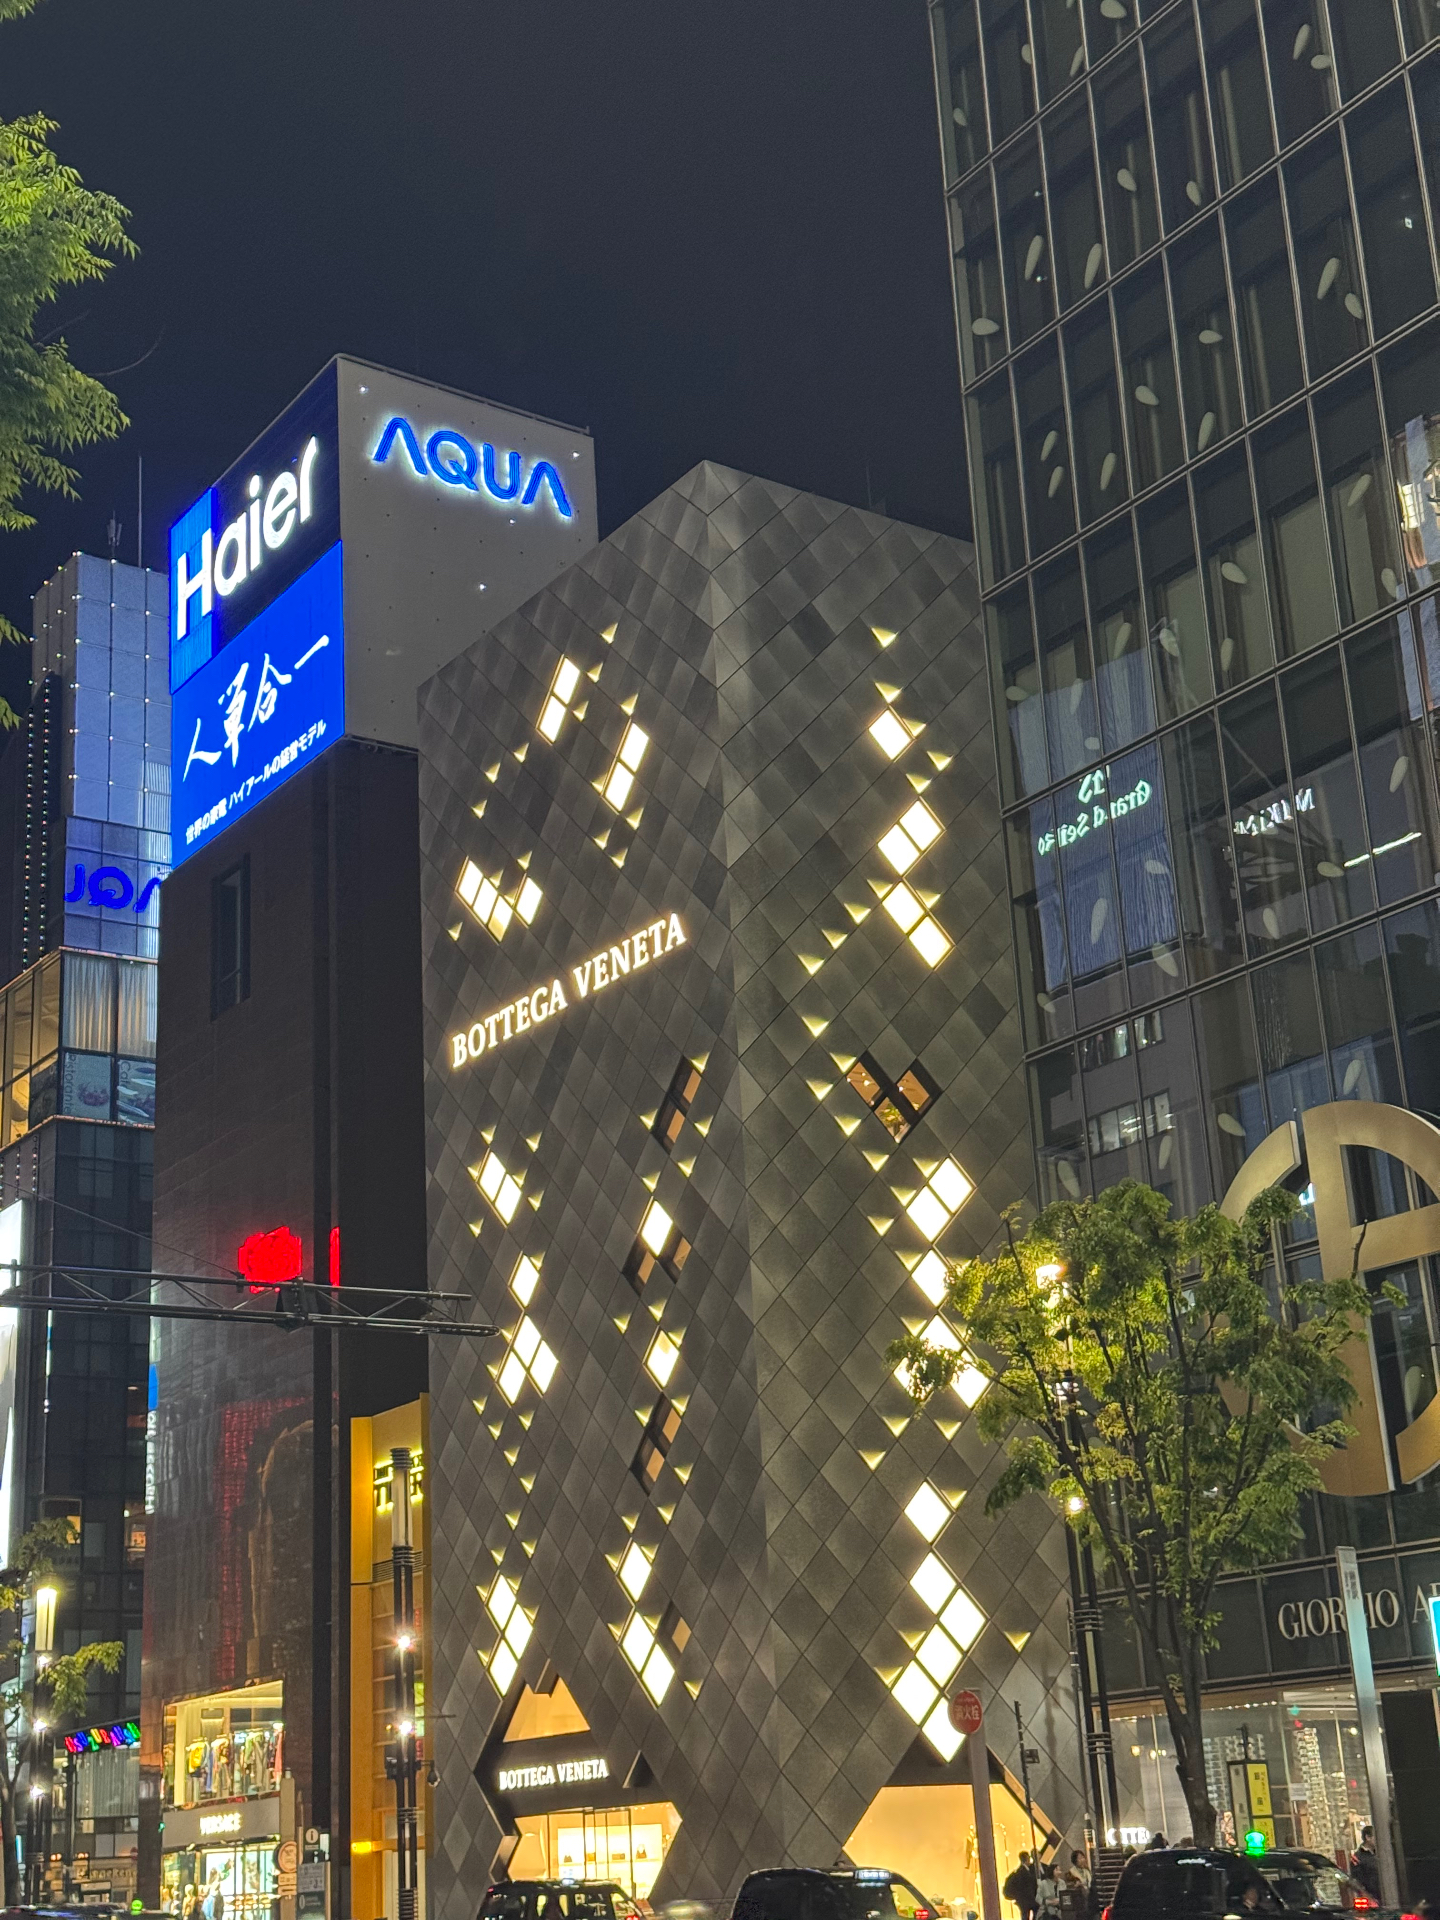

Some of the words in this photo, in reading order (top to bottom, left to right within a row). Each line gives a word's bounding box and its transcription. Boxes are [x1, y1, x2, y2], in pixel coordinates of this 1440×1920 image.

[371, 416, 573, 519] AQUA
[177, 436, 318, 641] Haier
[452, 979, 569, 1068] BOTTEGA
[572, 911, 688, 999] VENETA
[1278, 1588, 1401, 1641] GIORIO
[499, 1764, 557, 1791] BOTTEGA
[556, 1758, 610, 1784] VENETA
